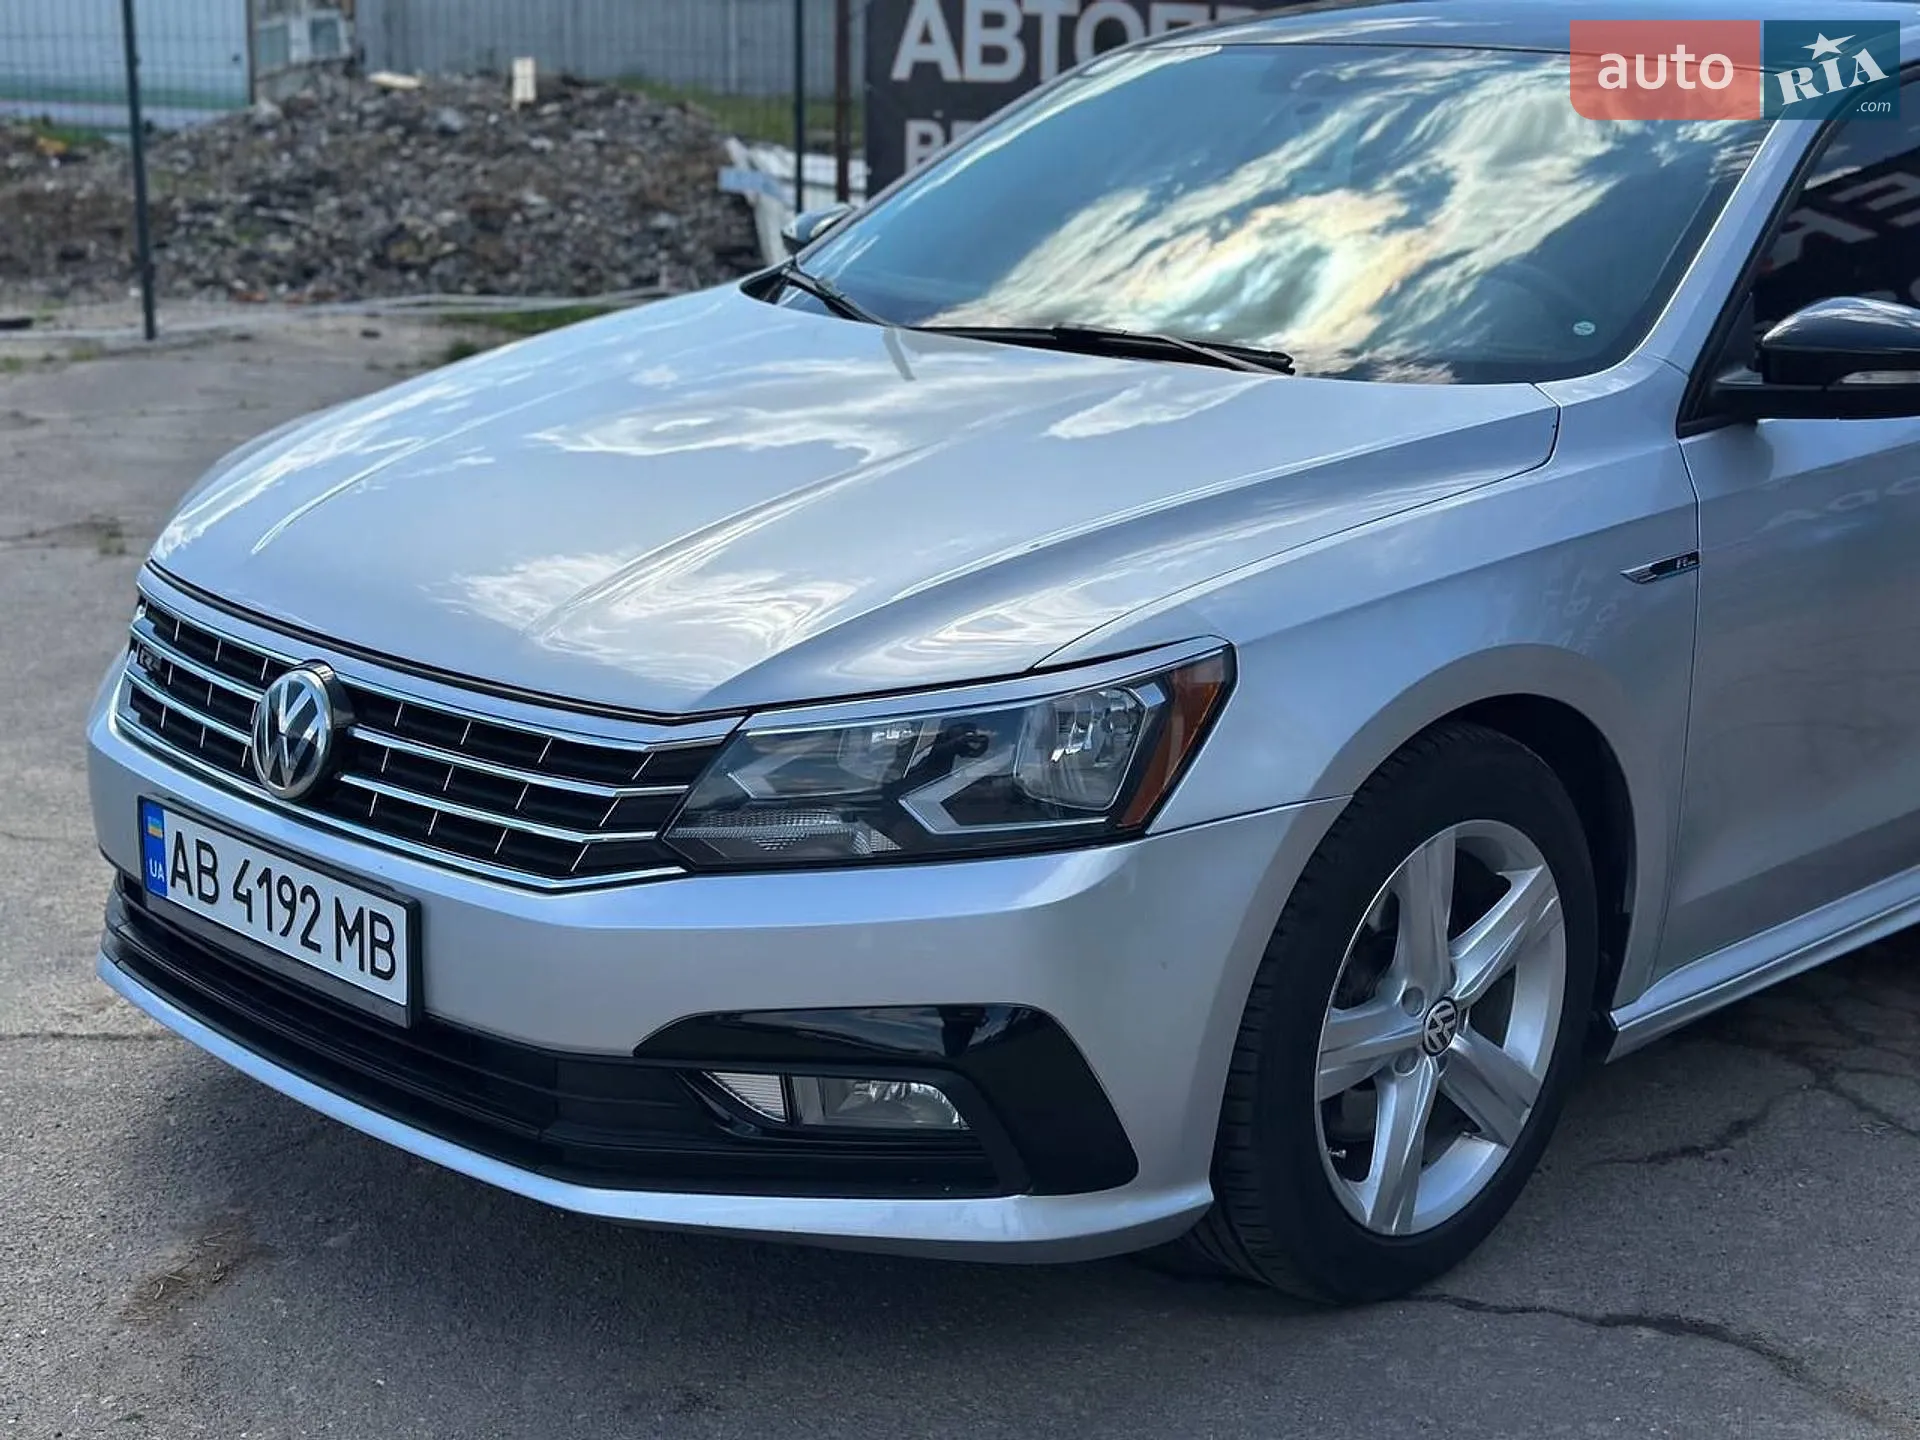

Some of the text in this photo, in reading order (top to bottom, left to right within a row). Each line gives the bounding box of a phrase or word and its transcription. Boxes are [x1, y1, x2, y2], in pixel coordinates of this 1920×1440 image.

[149, 857, 165, 882] UA
[170, 831, 396, 981] AB 4192 MB
